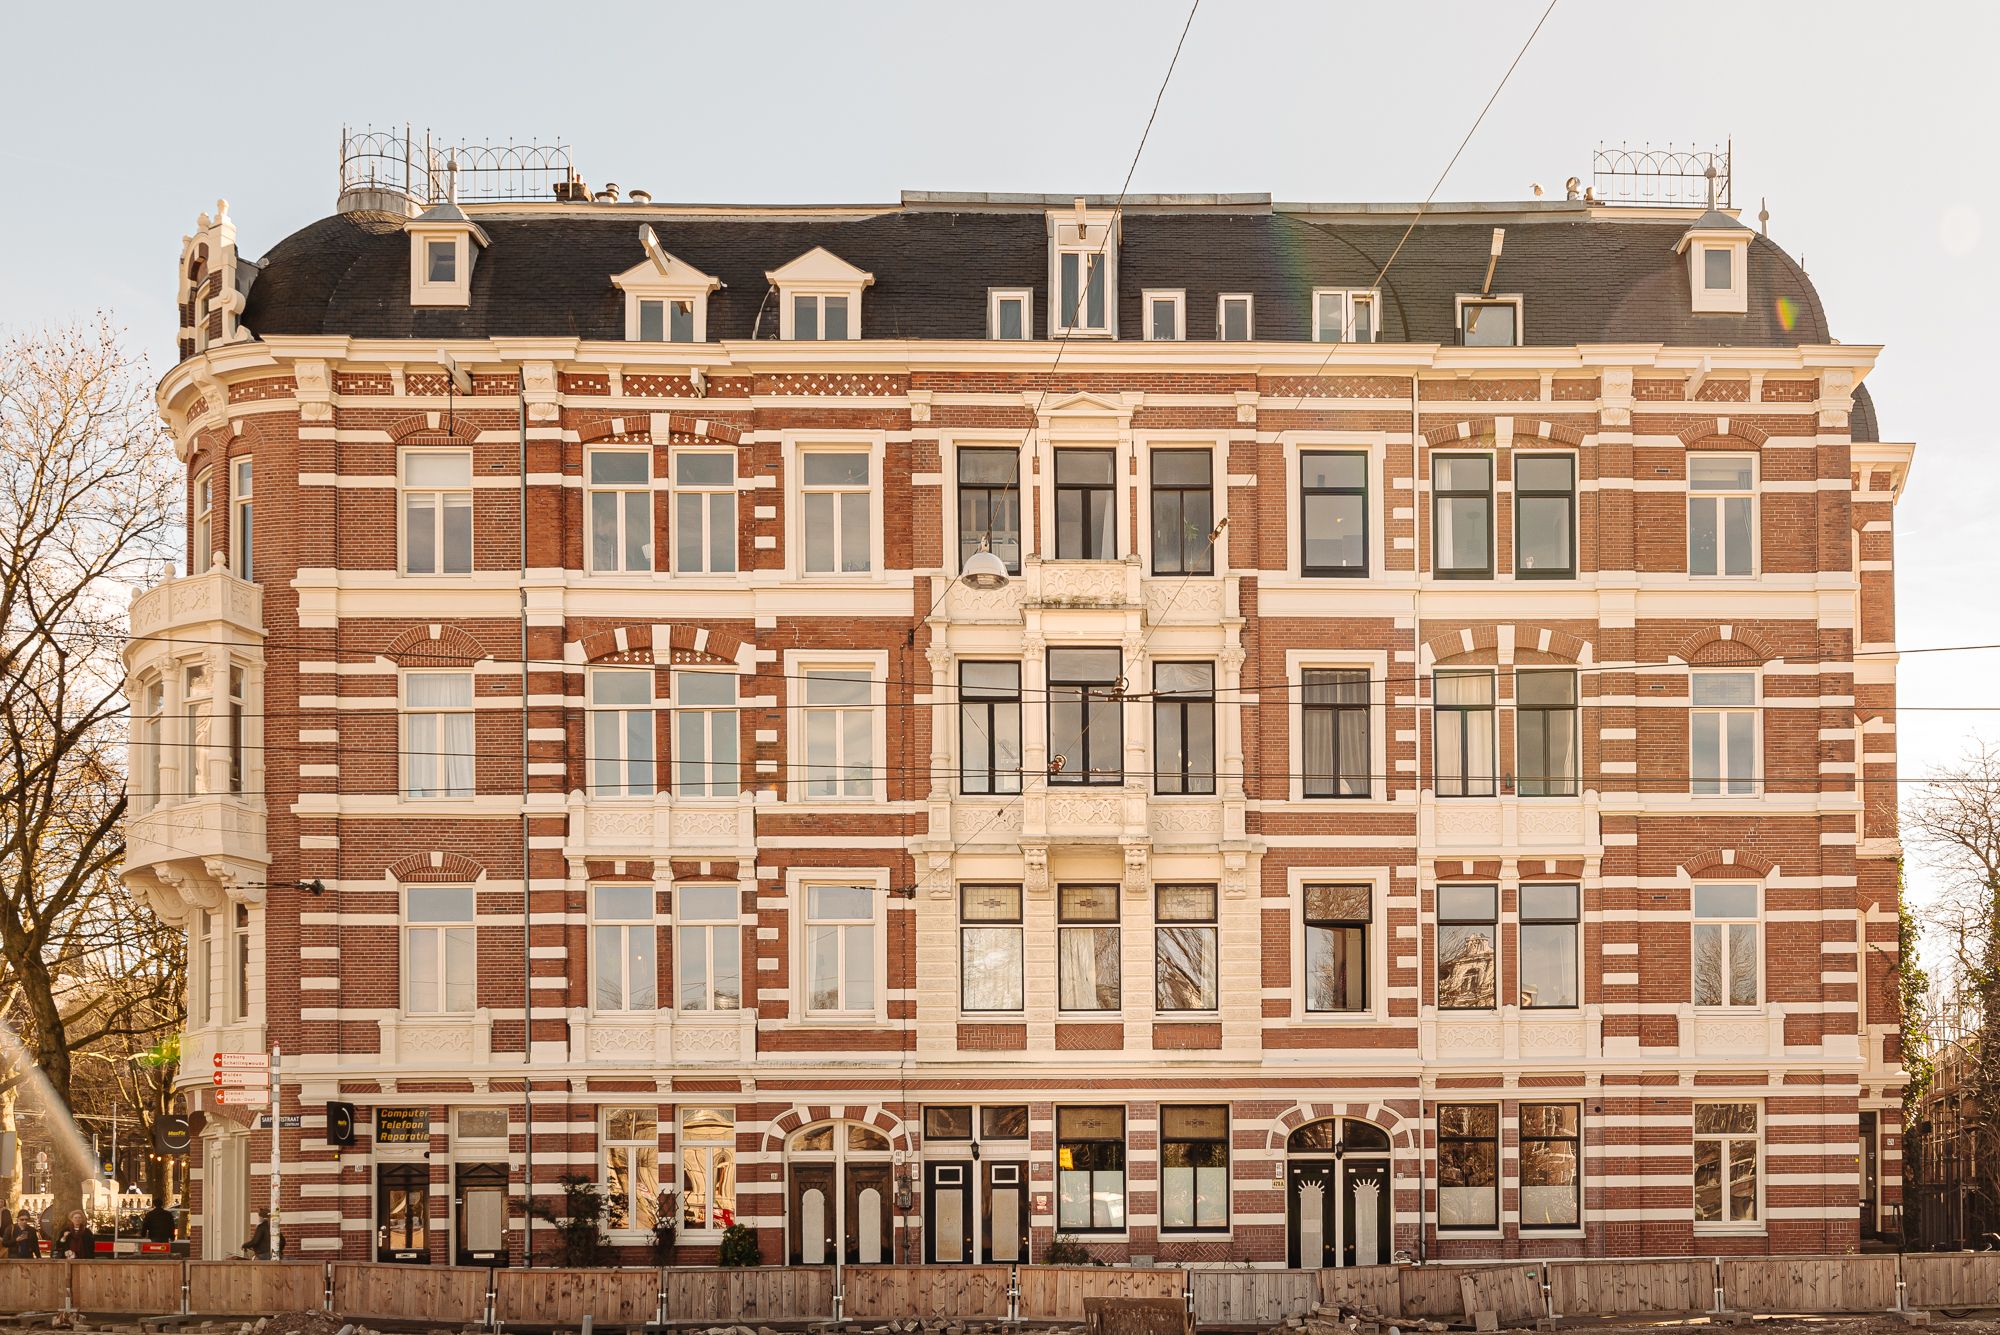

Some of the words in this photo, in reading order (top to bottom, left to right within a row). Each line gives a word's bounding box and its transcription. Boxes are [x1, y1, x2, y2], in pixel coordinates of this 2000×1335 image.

[381, 1109, 429, 1119] Computer
[381, 1120, 424, 1129] Telefoon
[380, 1132, 430, 1142] Reparatie
